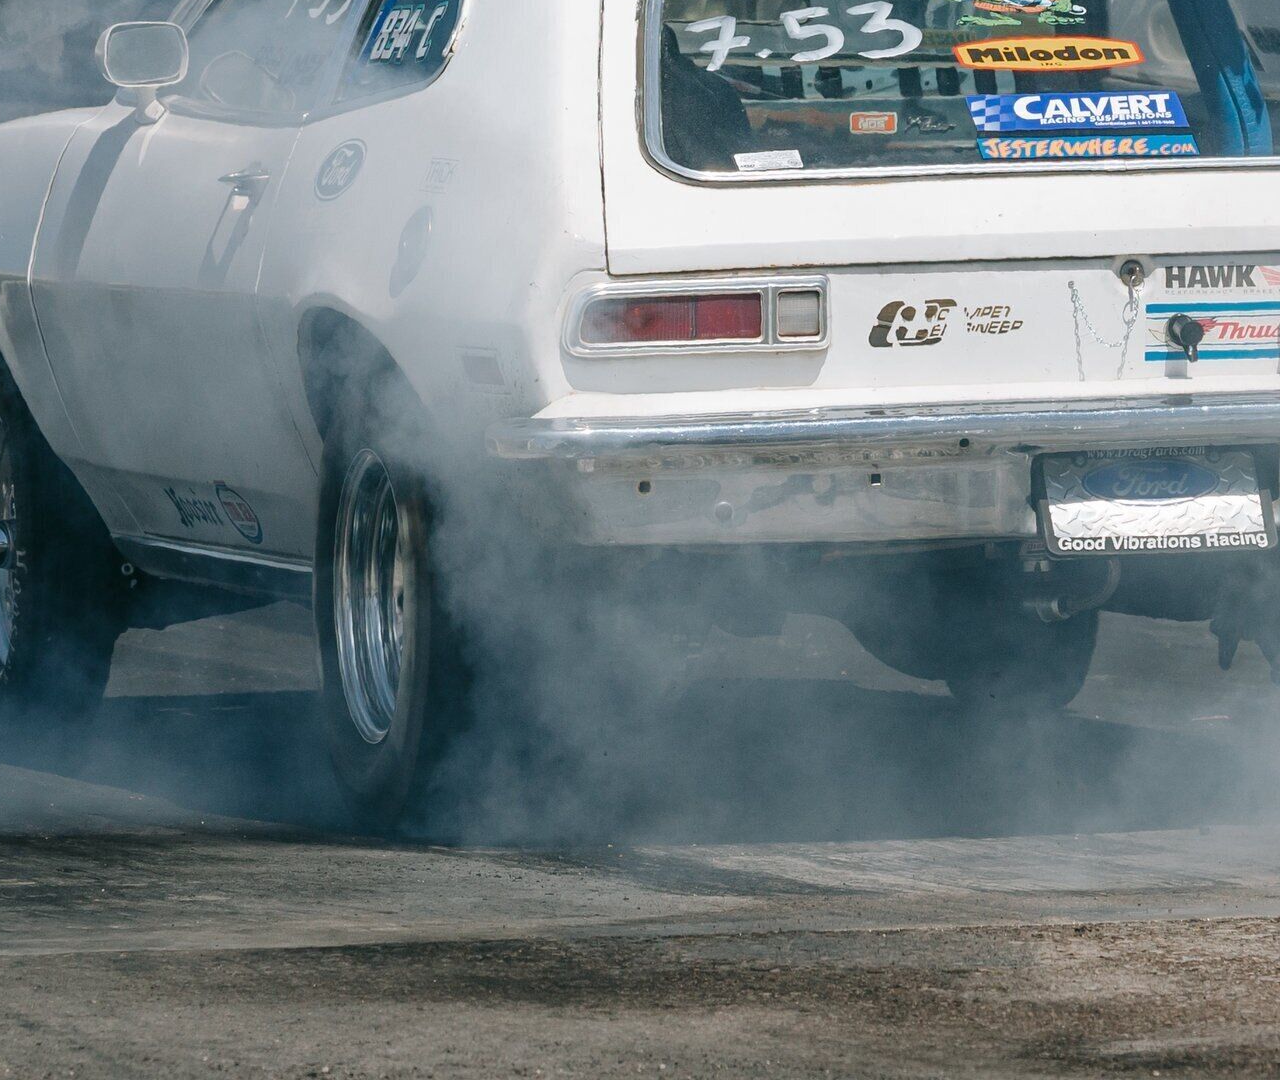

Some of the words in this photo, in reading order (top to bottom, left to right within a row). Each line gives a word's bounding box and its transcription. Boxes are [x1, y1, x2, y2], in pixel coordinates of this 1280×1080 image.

[684, 1, 923, 71] 7.53
[966, 44, 1131, 64] Milodon
[1013, 93, 1170, 120] CALVERT
[1040, 116, 1086, 126] RACING
[1090, 111, 1172, 123] SUSPENSIONS
[1164, 265, 1257, 289] HAWK
[1086, 445, 1206, 460] www.DragParts.com
[1112, 467, 1189, 497] Ford
[1057, 535, 1106, 551] Good
[1112, 533, 1202, 551] Vibrations
[1205, 531, 1269, 548] Racing
